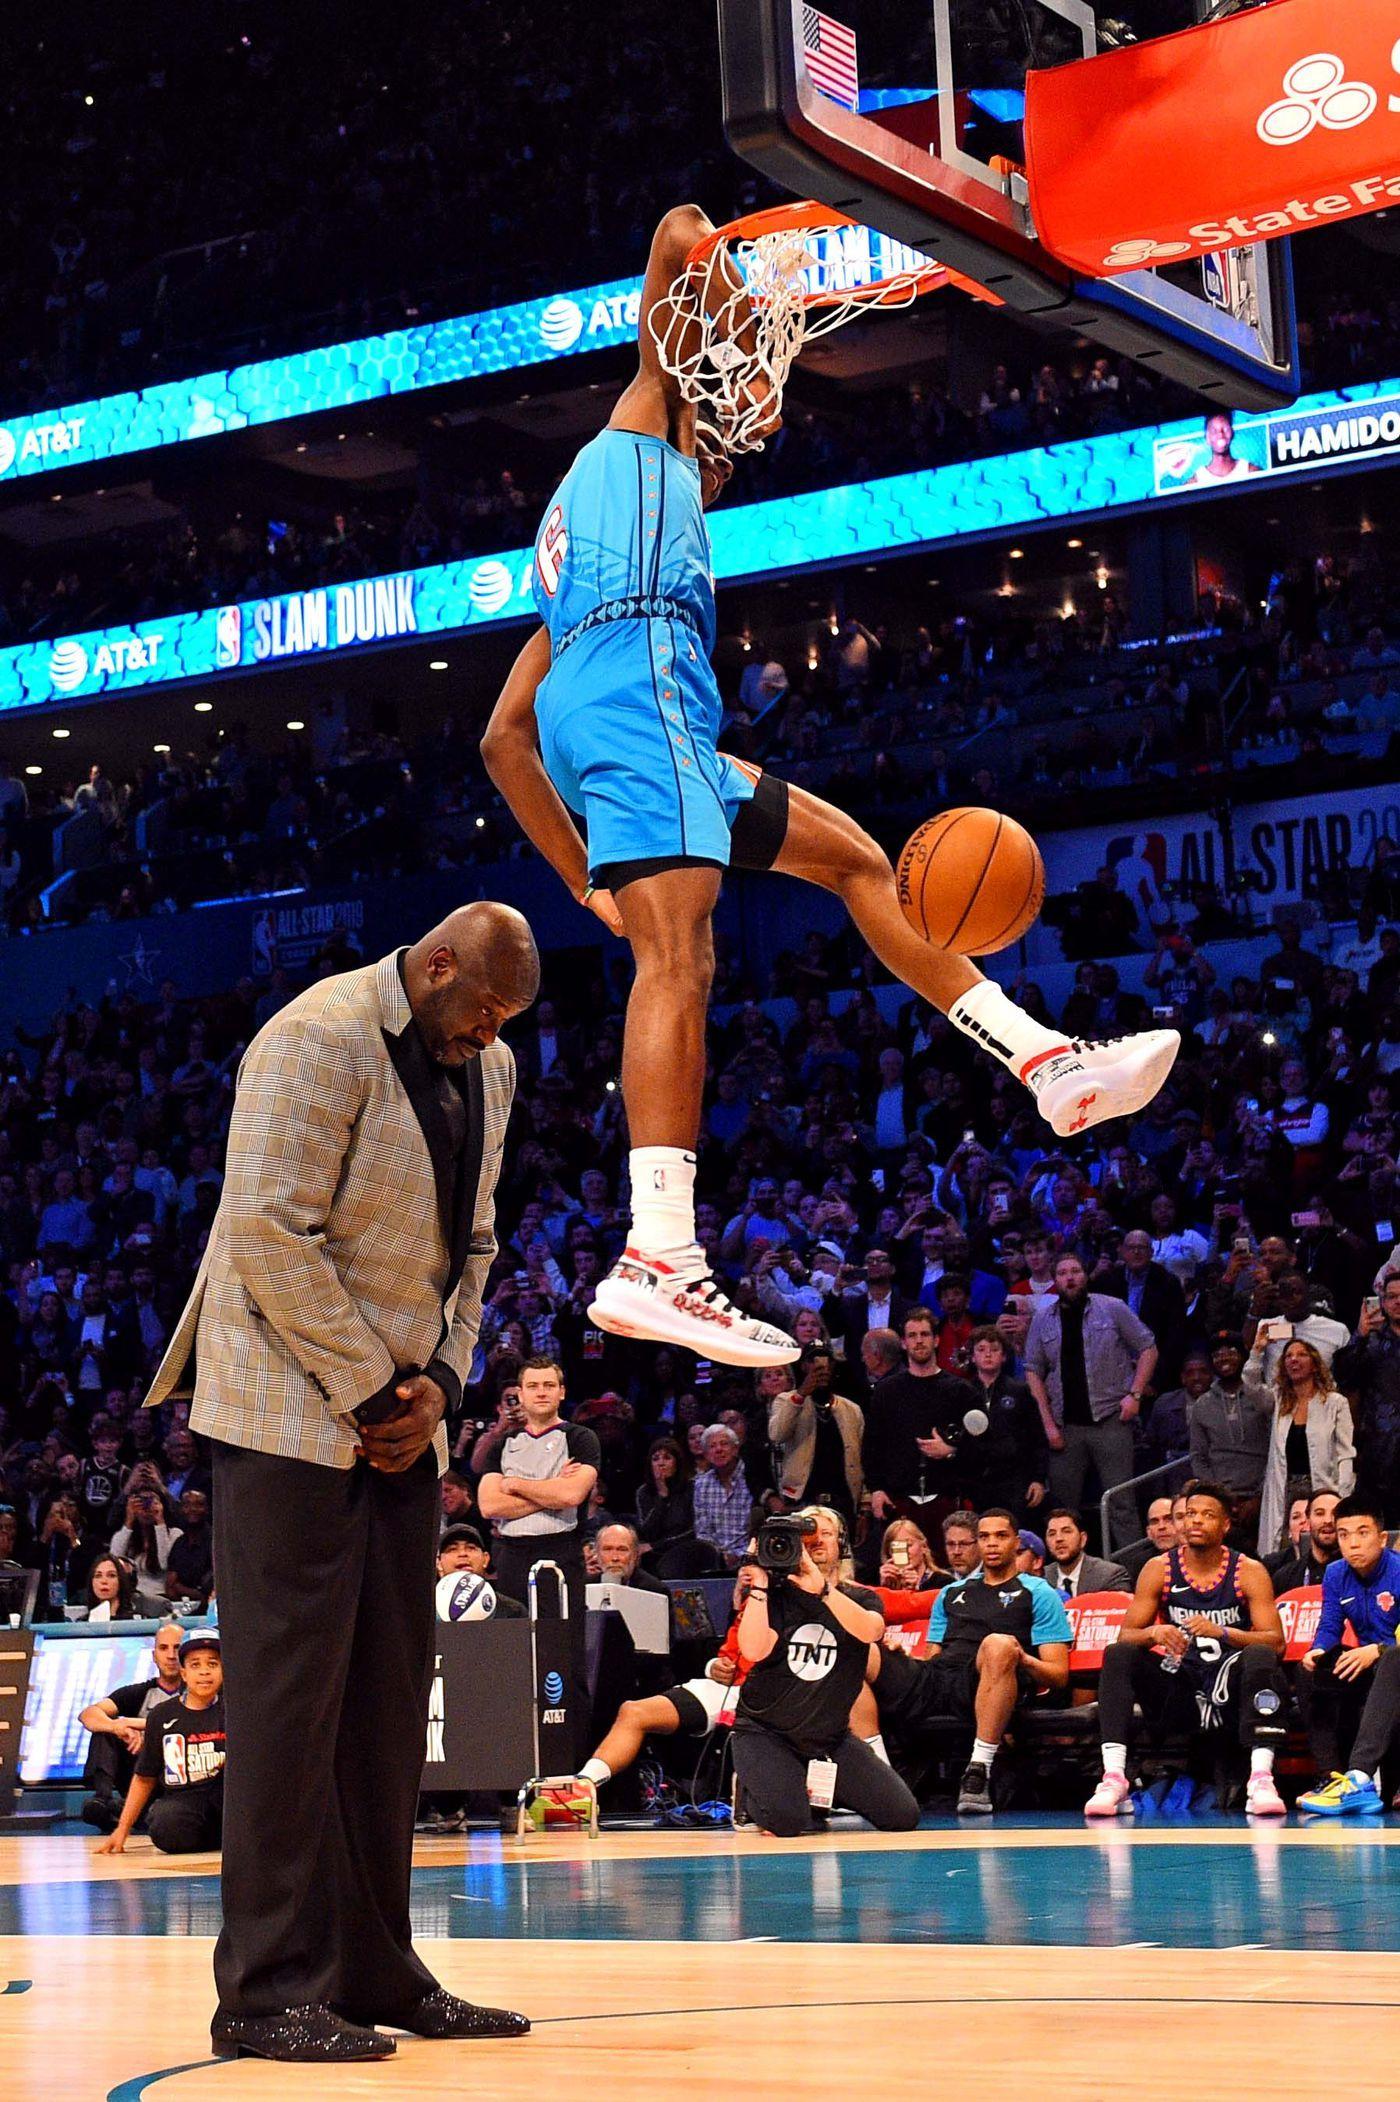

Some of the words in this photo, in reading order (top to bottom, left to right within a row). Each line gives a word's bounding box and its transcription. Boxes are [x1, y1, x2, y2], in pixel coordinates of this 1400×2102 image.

[1188, 194, 1353, 247] State
[588, 290, 642, 334] AT&
[20, 417, 86, 461] AT&T
[253, 590, 327, 660] SLAM
[335, 574, 418, 646] DUNK
[93, 634, 164, 677] AT&T
[1076, 1625, 1121, 1642] SATURDA
[1200, 1605, 1241, 1626] YORK
[786, 1641, 838, 1667] TNT
[542, 1708, 566, 1725] AT&T
